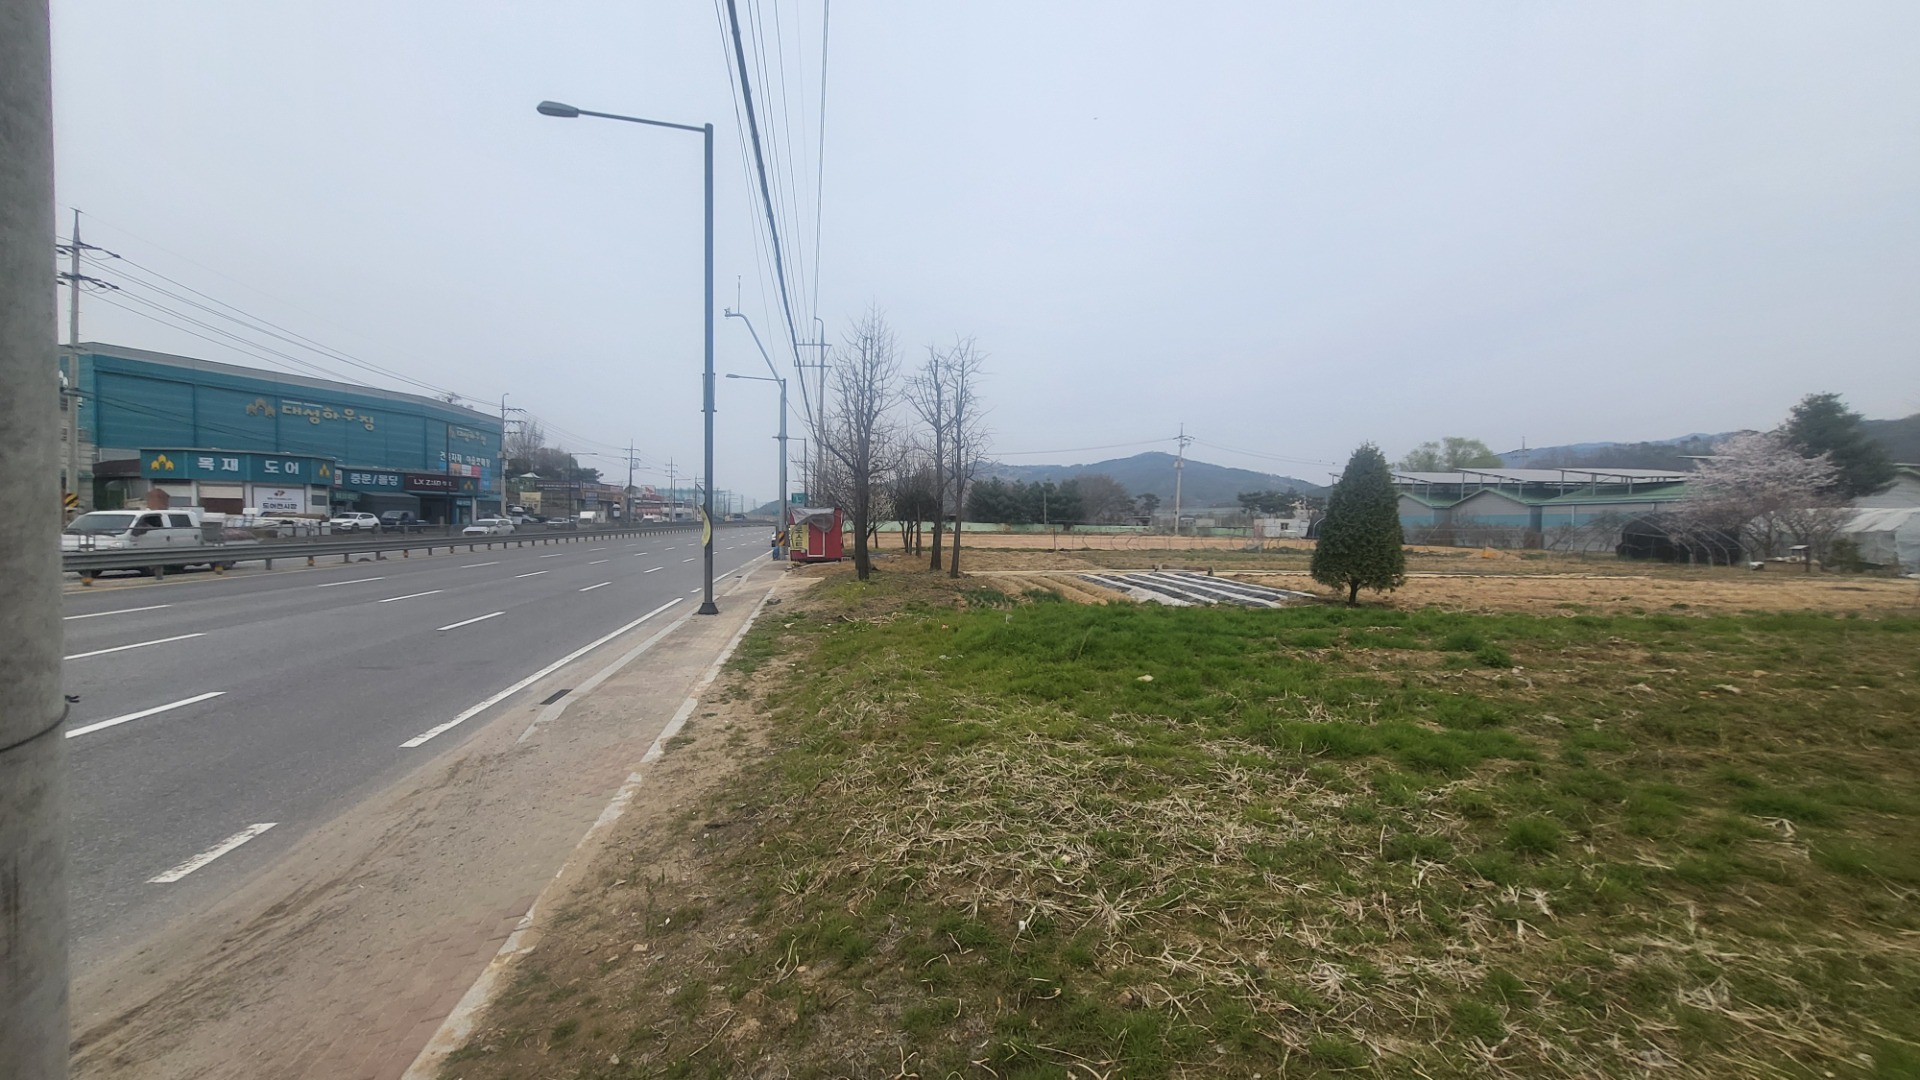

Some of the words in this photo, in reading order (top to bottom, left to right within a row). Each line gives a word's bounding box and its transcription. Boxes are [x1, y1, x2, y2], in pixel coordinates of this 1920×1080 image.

[281, 404, 374, 431] 대성하우징
[198, 456, 239, 472] 목재
[264, 459, 300, 475] 도어
[350, 473, 398, 487] 중문/몰딩
[262, 502, 298, 510] 도어전시장
